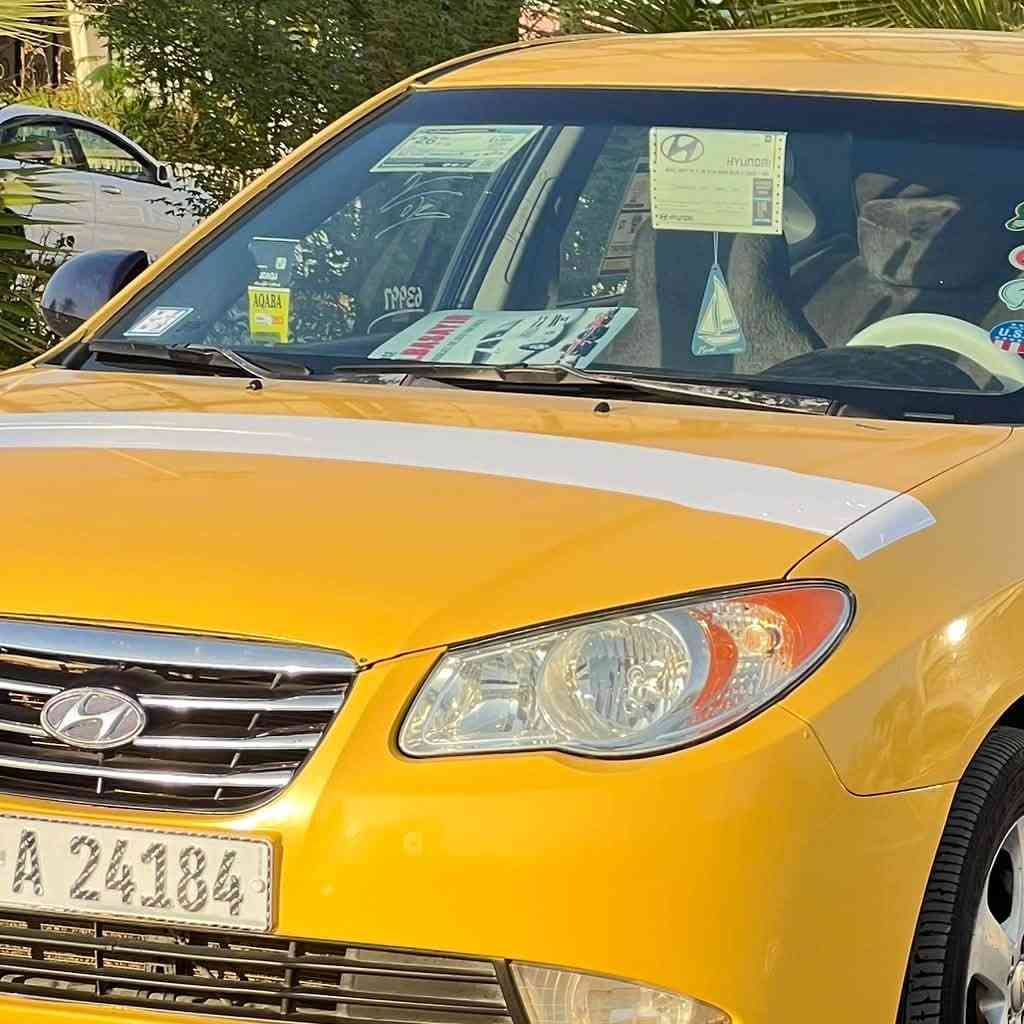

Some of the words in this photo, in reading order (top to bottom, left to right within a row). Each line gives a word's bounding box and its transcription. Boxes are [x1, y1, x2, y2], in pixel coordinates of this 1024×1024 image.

[253, 293, 282, 310] AQABA
[12, 829, 44, 896] A
[70, 832, 244, 916] 24184
